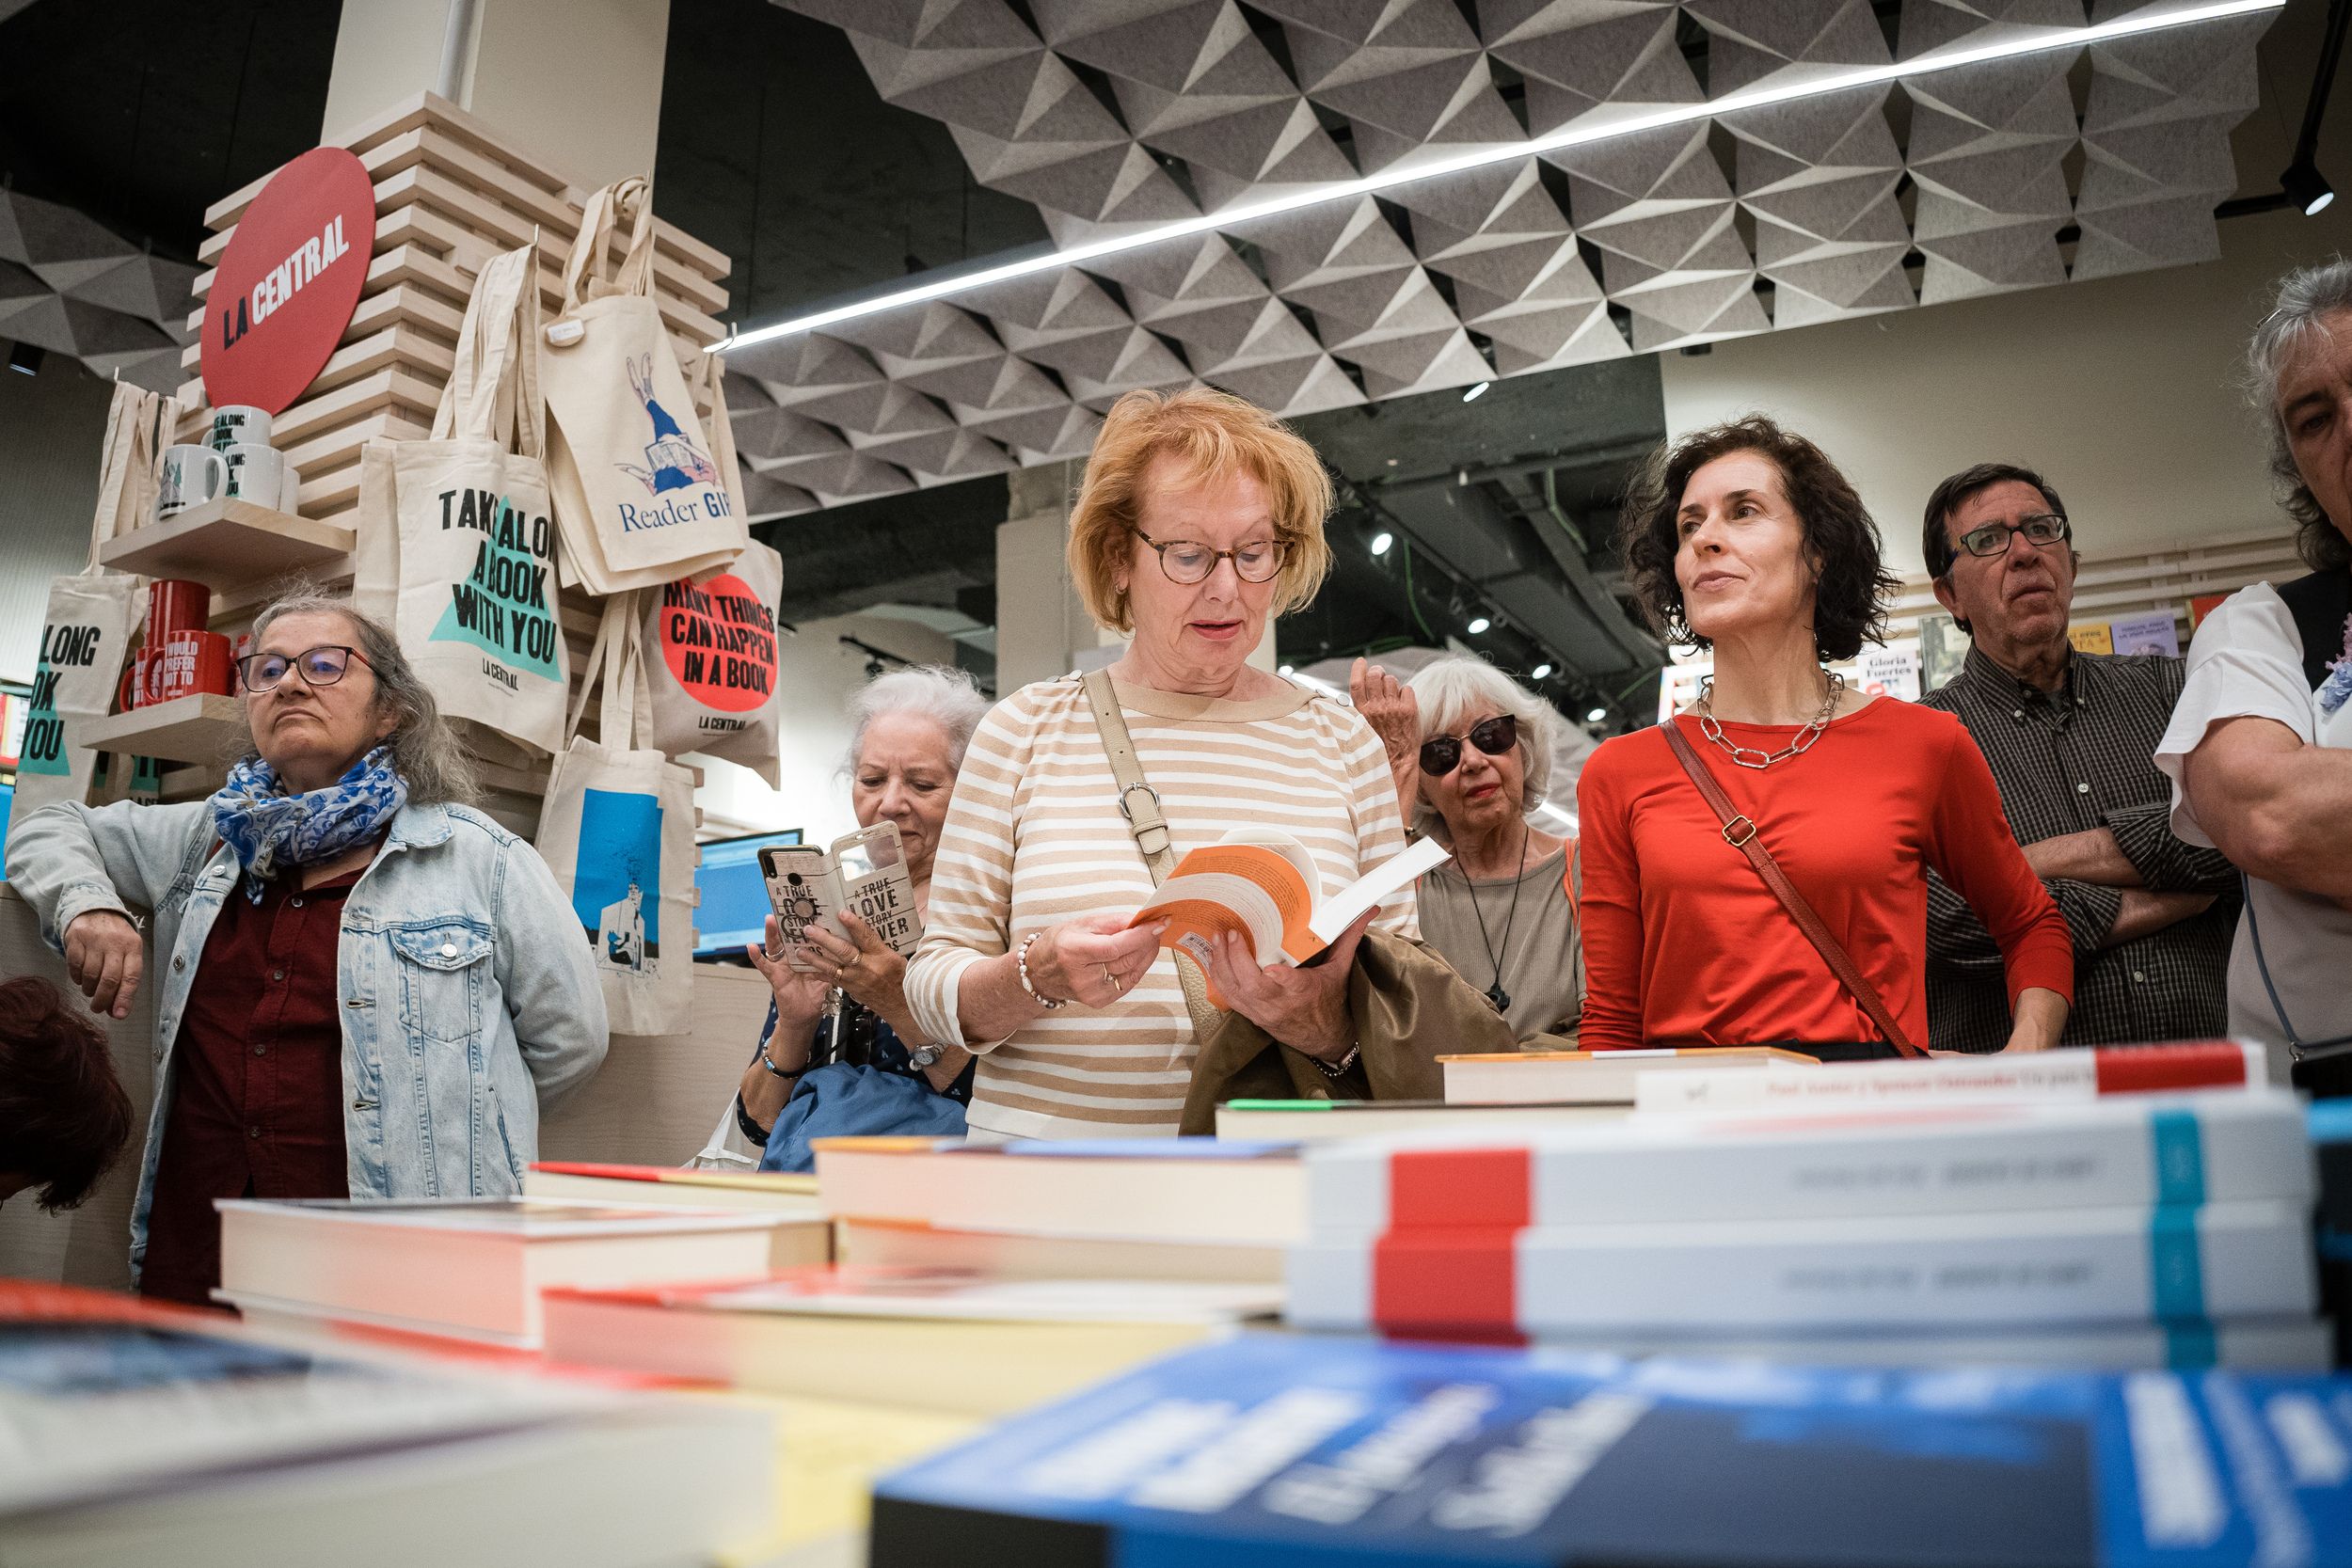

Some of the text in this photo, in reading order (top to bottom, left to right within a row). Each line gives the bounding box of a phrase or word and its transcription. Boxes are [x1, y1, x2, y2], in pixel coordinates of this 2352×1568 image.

[224, 214, 350, 351] LA CENTRAL
[225, 453, 246, 467] LONG
[618, 498, 698, 533] Reader
[497, 507, 554, 562] ALO
[472, 540, 548, 610] A BOOK
[452, 583, 557, 664] WITH YOU
[663, 579, 775, 634] MANY THINGS
[40, 625, 101, 666] LONG
[671, 613, 774, 666] CAN HAPPEN
[180, 671, 194, 686] TO
[482, 657, 491, 676] LA
[491, 662, 519, 691] CENTRAL
[683, 650, 769, 696] IN A BOOK
[1867, 667, 1912, 678] Fuertes
[1869, 657, 1907, 667] Gloria
[21, 718, 65, 761] YOU
[698, 716, 709, 730] LA
[783, 885, 813, 897] TRUE
[850, 888, 899, 917] LOVE
[861, 877, 891, 895] TRUE
[772, 897, 822, 917] LOE
[865, 910, 894, 927] STORY
